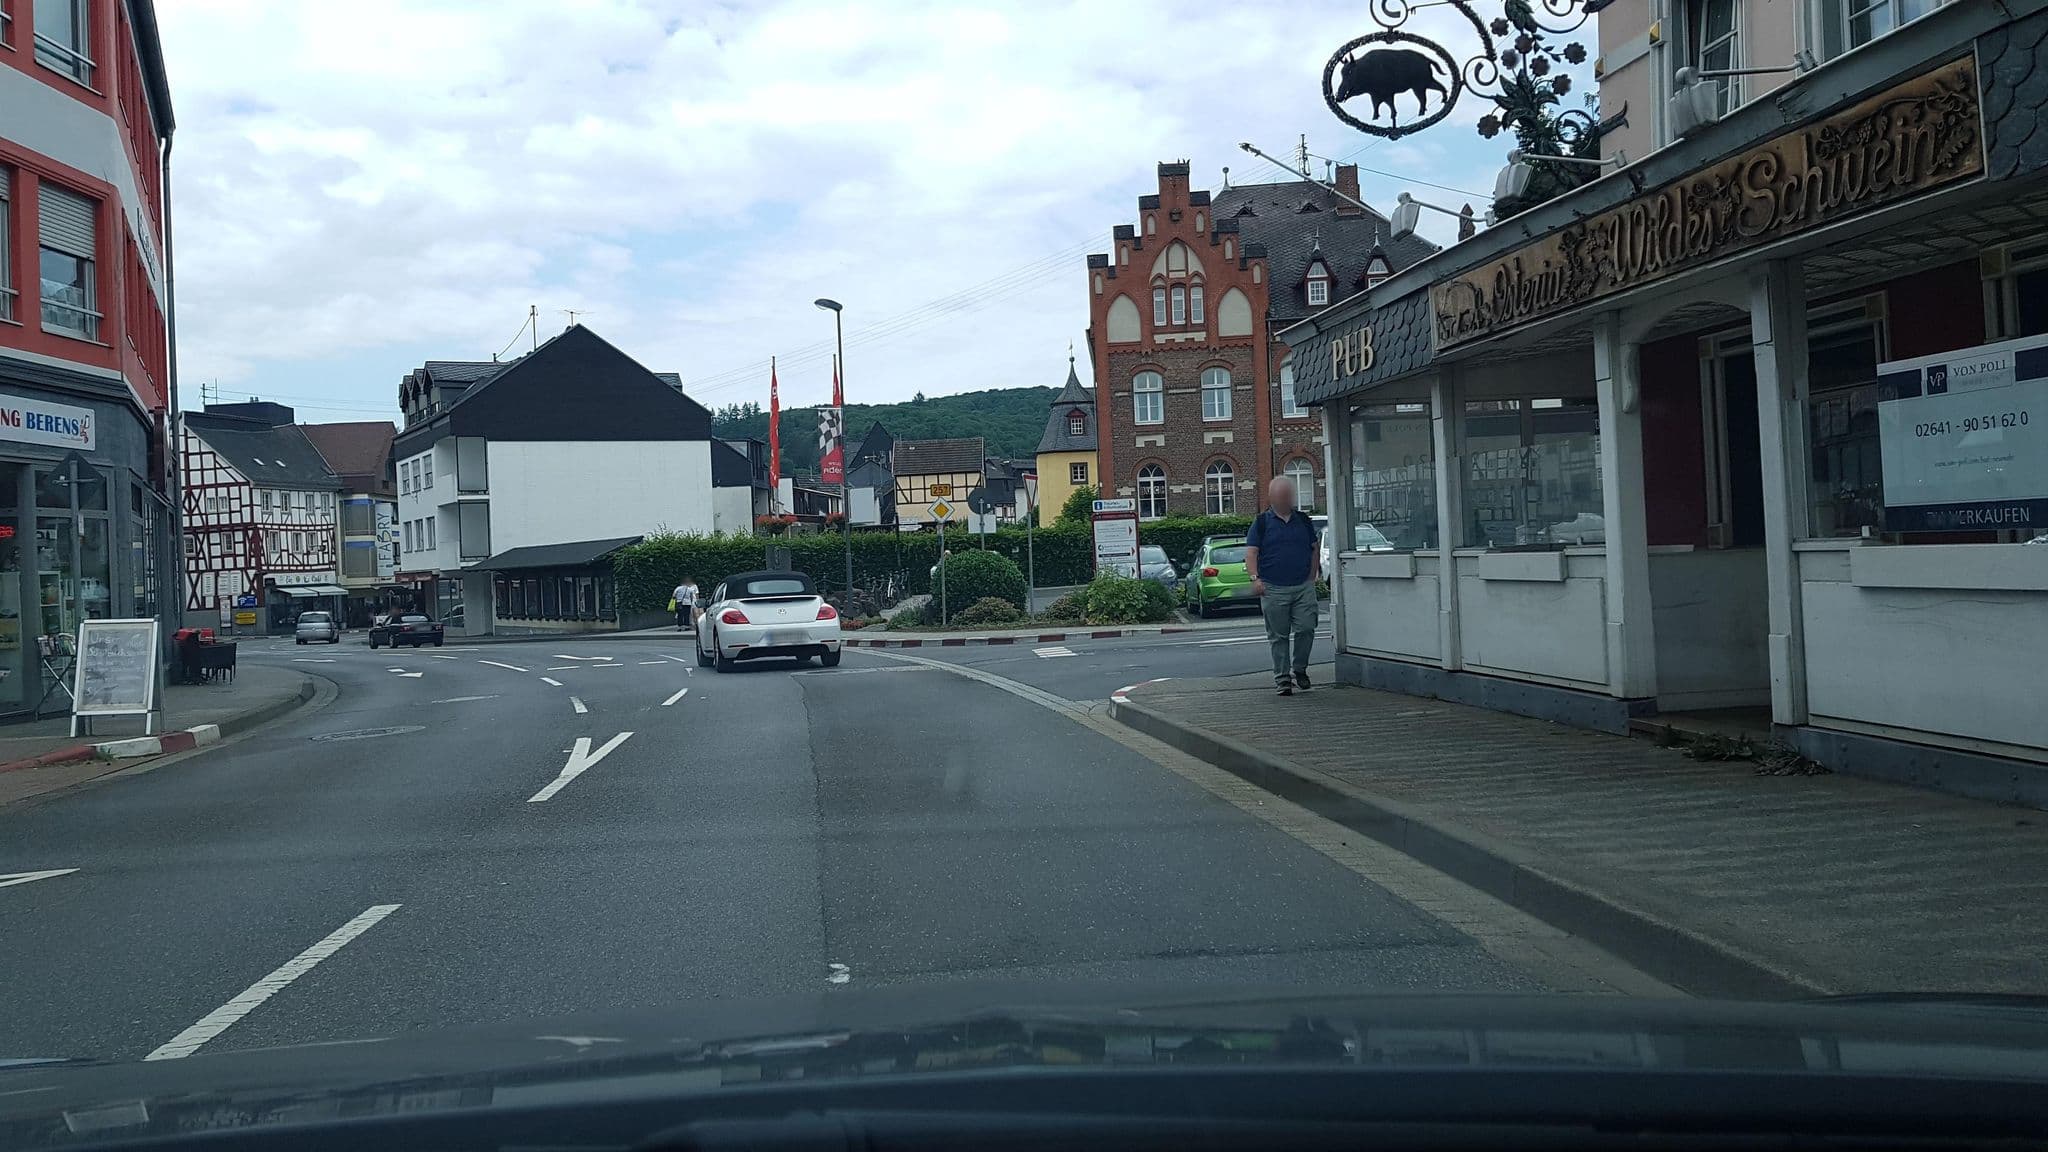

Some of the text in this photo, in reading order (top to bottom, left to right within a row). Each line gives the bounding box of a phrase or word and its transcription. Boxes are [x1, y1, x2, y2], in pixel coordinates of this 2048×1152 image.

[1609, 186, 1714, 282] Wildes
[1737, 117, 1943, 237] Schwein
[1331, 326, 1374, 380] PUB
[1953, 364, 1977, 377] VON
[26, 411, 80, 436] BERENS
[1915, 420, 1951, 437] 02641
[1963, 417, 1979, 432] 90
[1982, 415, 1996, 430] 51
[2001, 412, 2016, 427] 62
[2020, 411, 2029, 425] 0
[933, 486, 948, 495] 257
